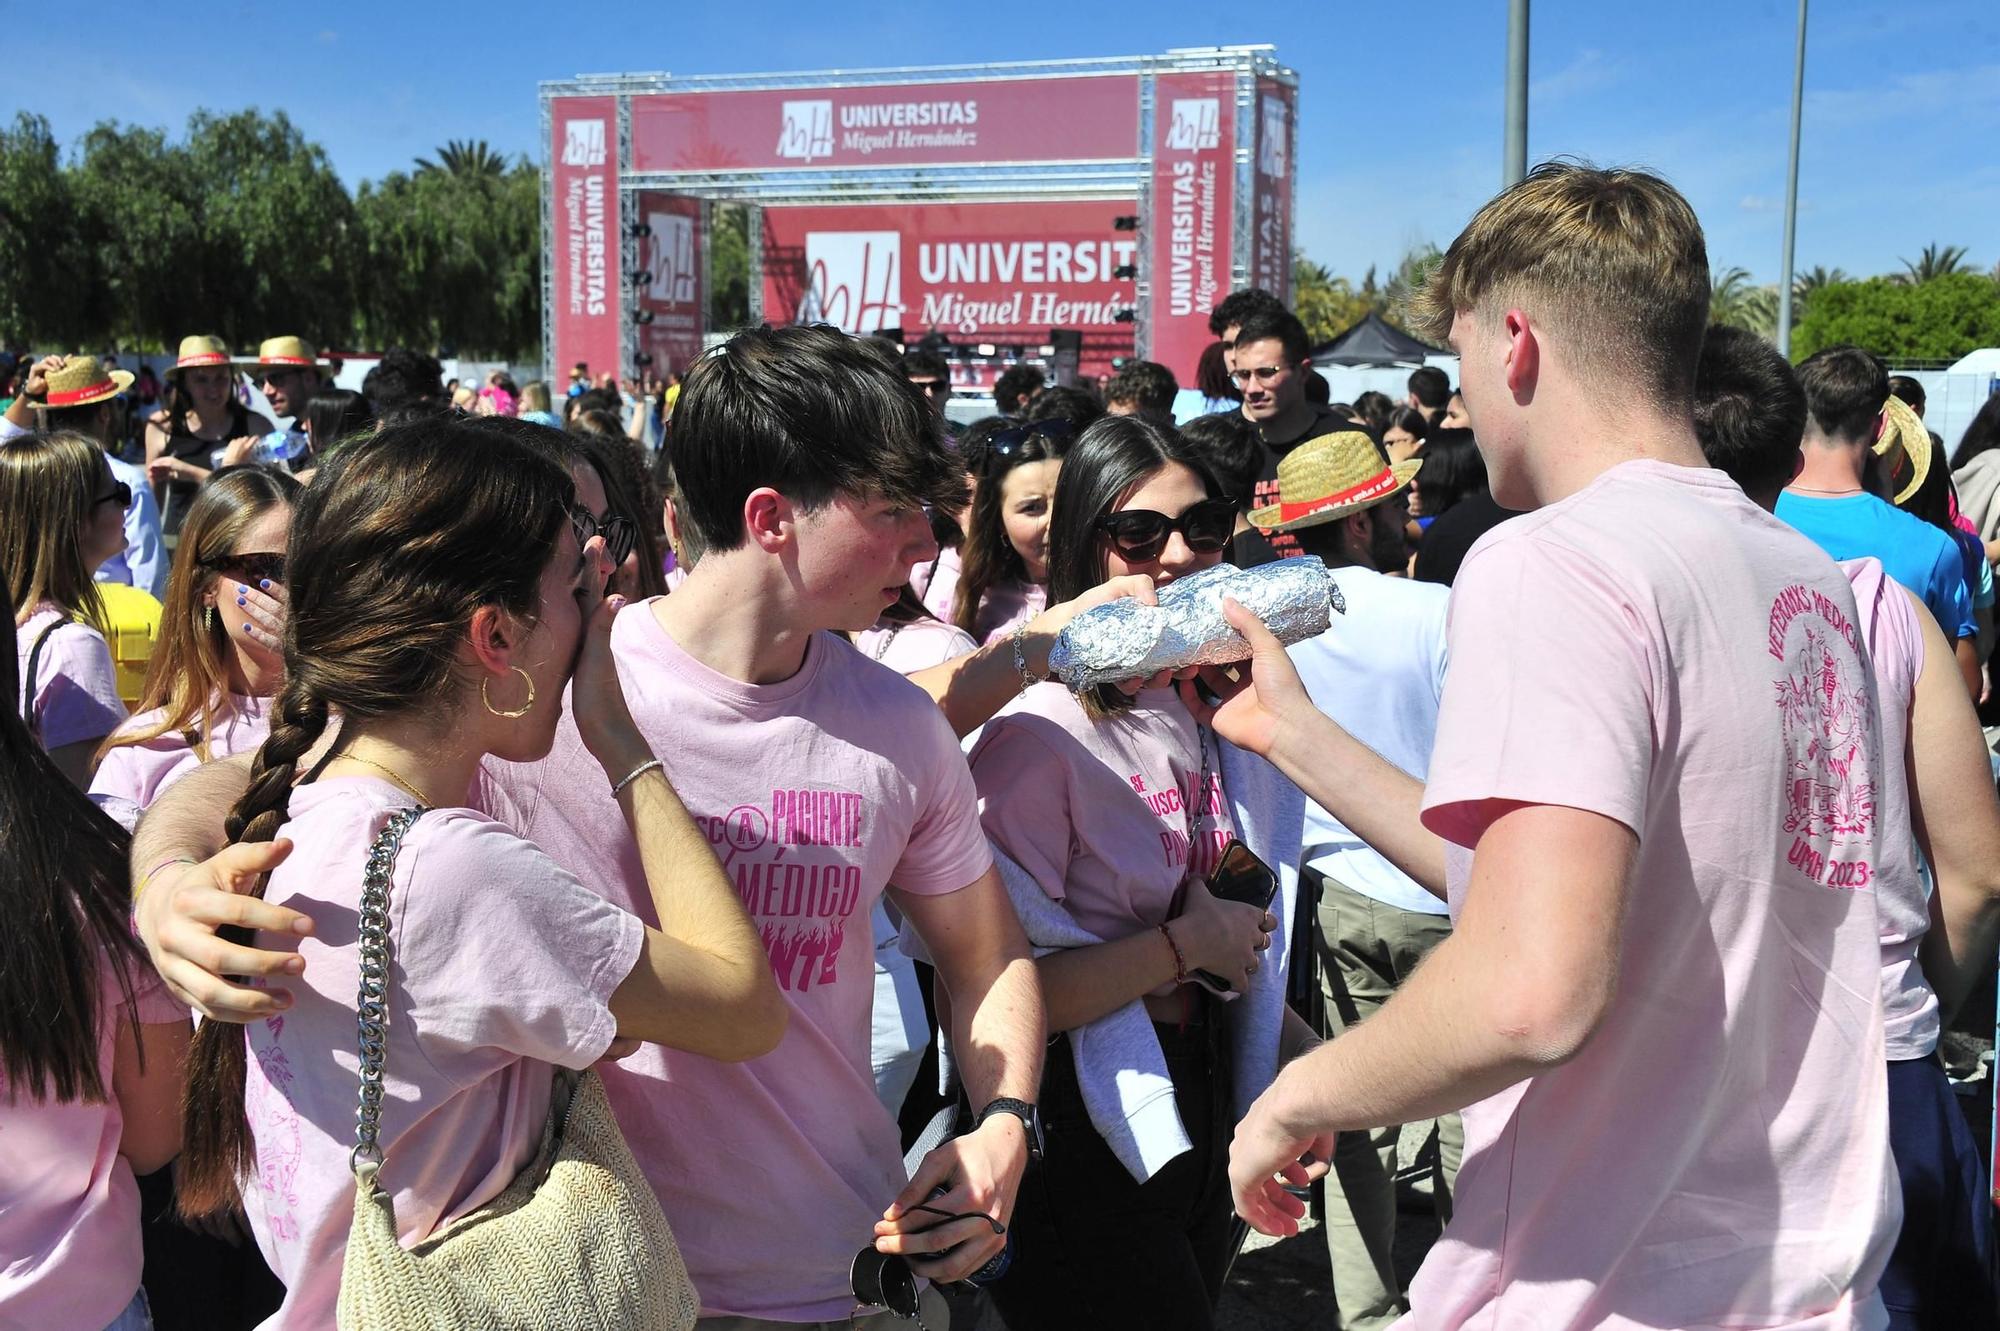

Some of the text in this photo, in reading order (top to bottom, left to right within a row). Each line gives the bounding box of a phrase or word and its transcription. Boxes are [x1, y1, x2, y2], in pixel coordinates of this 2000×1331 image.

[841, 101, 978, 128] UNIVERSITAS
[841, 128, 977, 155] Miguel Hernández
[565, 176, 585, 232] Miguel
[585, 175, 606, 316] UNIVERSITAS
[919, 240, 1136, 283] UNIVERSIT
[1171, 160, 1195, 316] UNIVERSITAS
[1195, 161, 1219, 315] Miguel Hernández
[569, 233, 586, 316] Hernández
[920, 290, 1136, 334] Miguel Herná
[1130, 774, 1148, 794] SE
[772, 789, 862, 848] PACIENTE
[736, 847, 862, 918] MÉDICO
